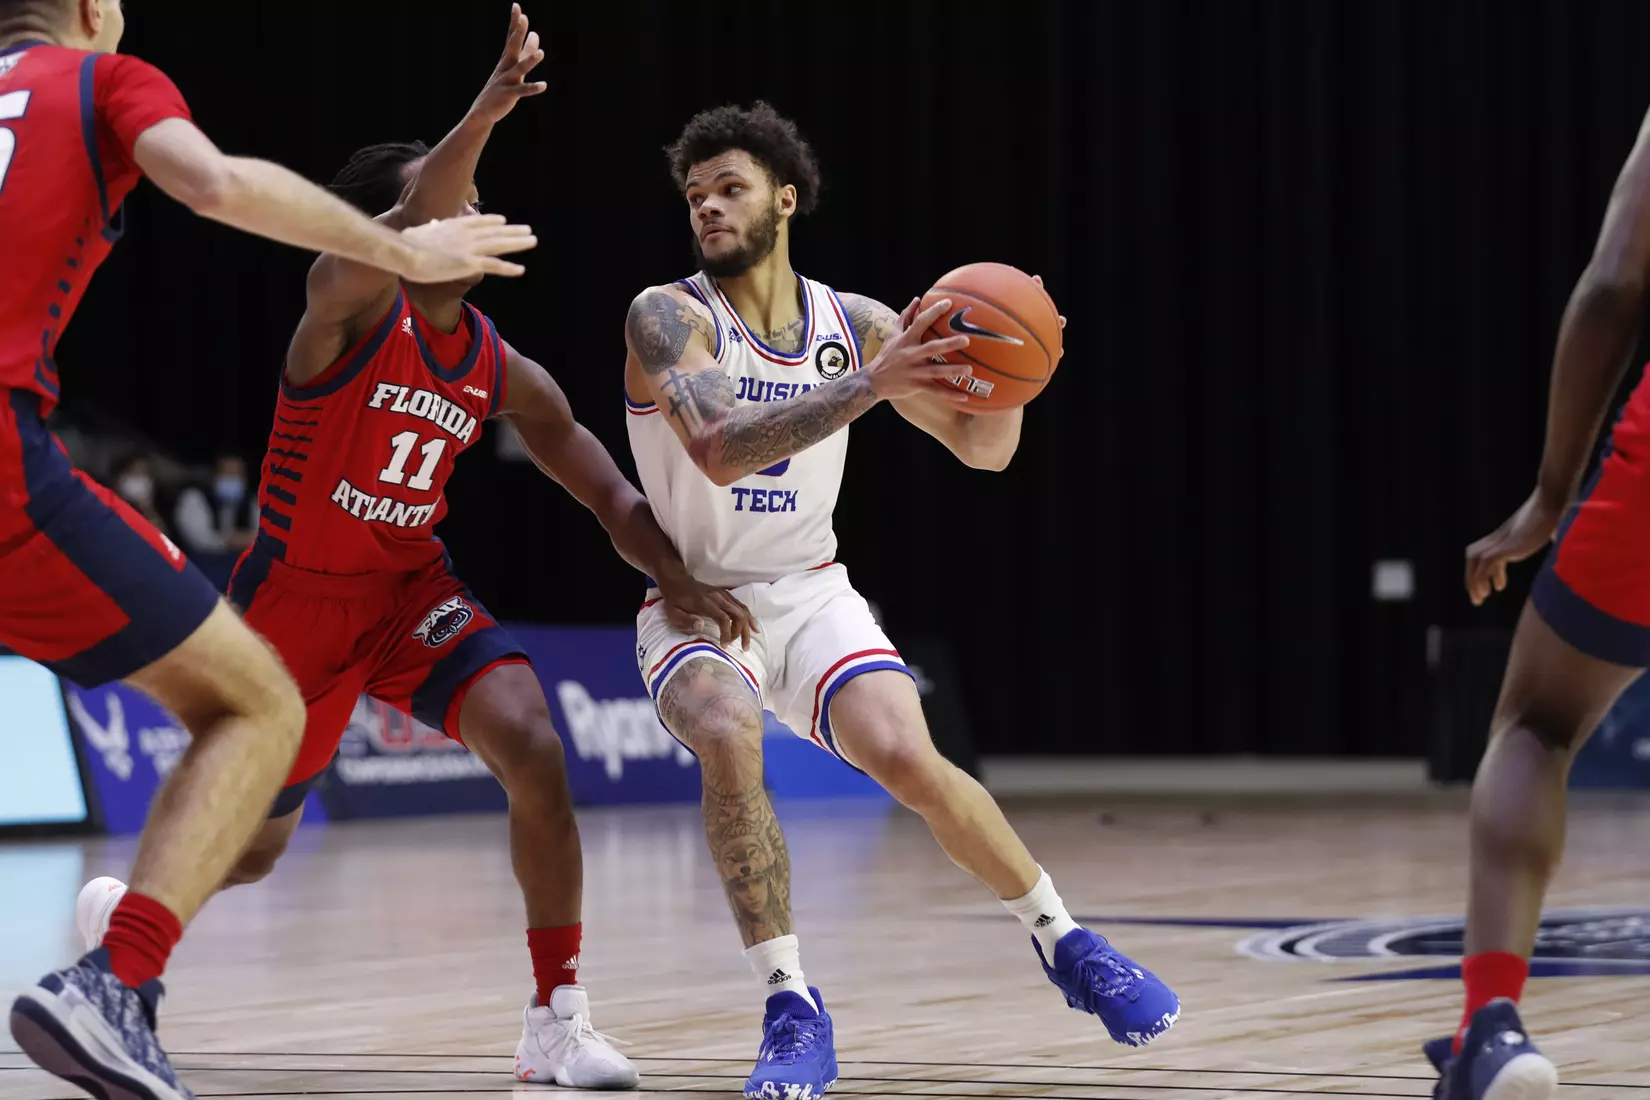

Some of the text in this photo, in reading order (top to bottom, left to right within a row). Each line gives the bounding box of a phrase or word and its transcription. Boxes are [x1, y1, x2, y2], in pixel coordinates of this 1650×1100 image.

[368, 383, 477, 444] FLORIDA
[378, 430, 447, 491] 11
[331, 479, 437, 528] ATLANTI
[731, 488, 799, 513] TECH
[415, 598, 460, 641] FAU
